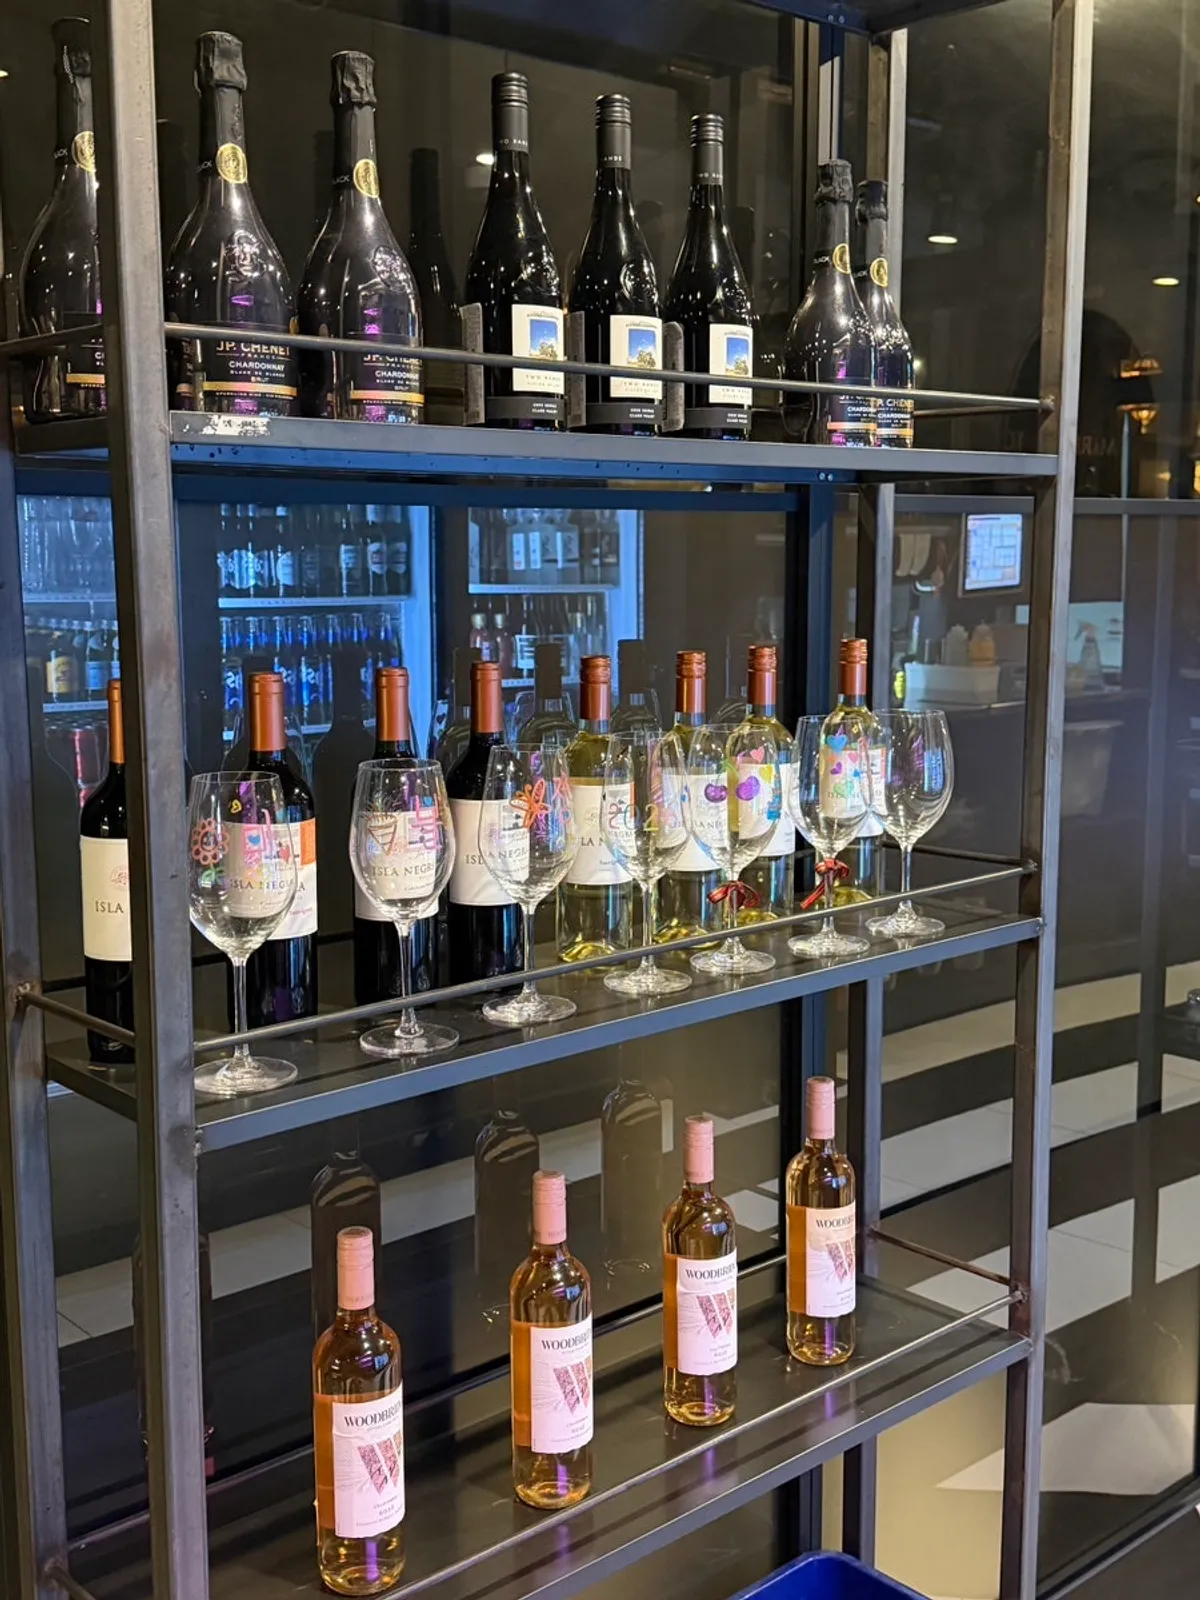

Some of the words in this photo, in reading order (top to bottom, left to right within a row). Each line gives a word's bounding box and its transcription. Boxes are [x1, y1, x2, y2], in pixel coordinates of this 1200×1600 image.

[228, 361, 285, 371] CHARDONNAY
[372, 865, 400, 877] ISLA
[94, 900, 124, 914] ISLA
